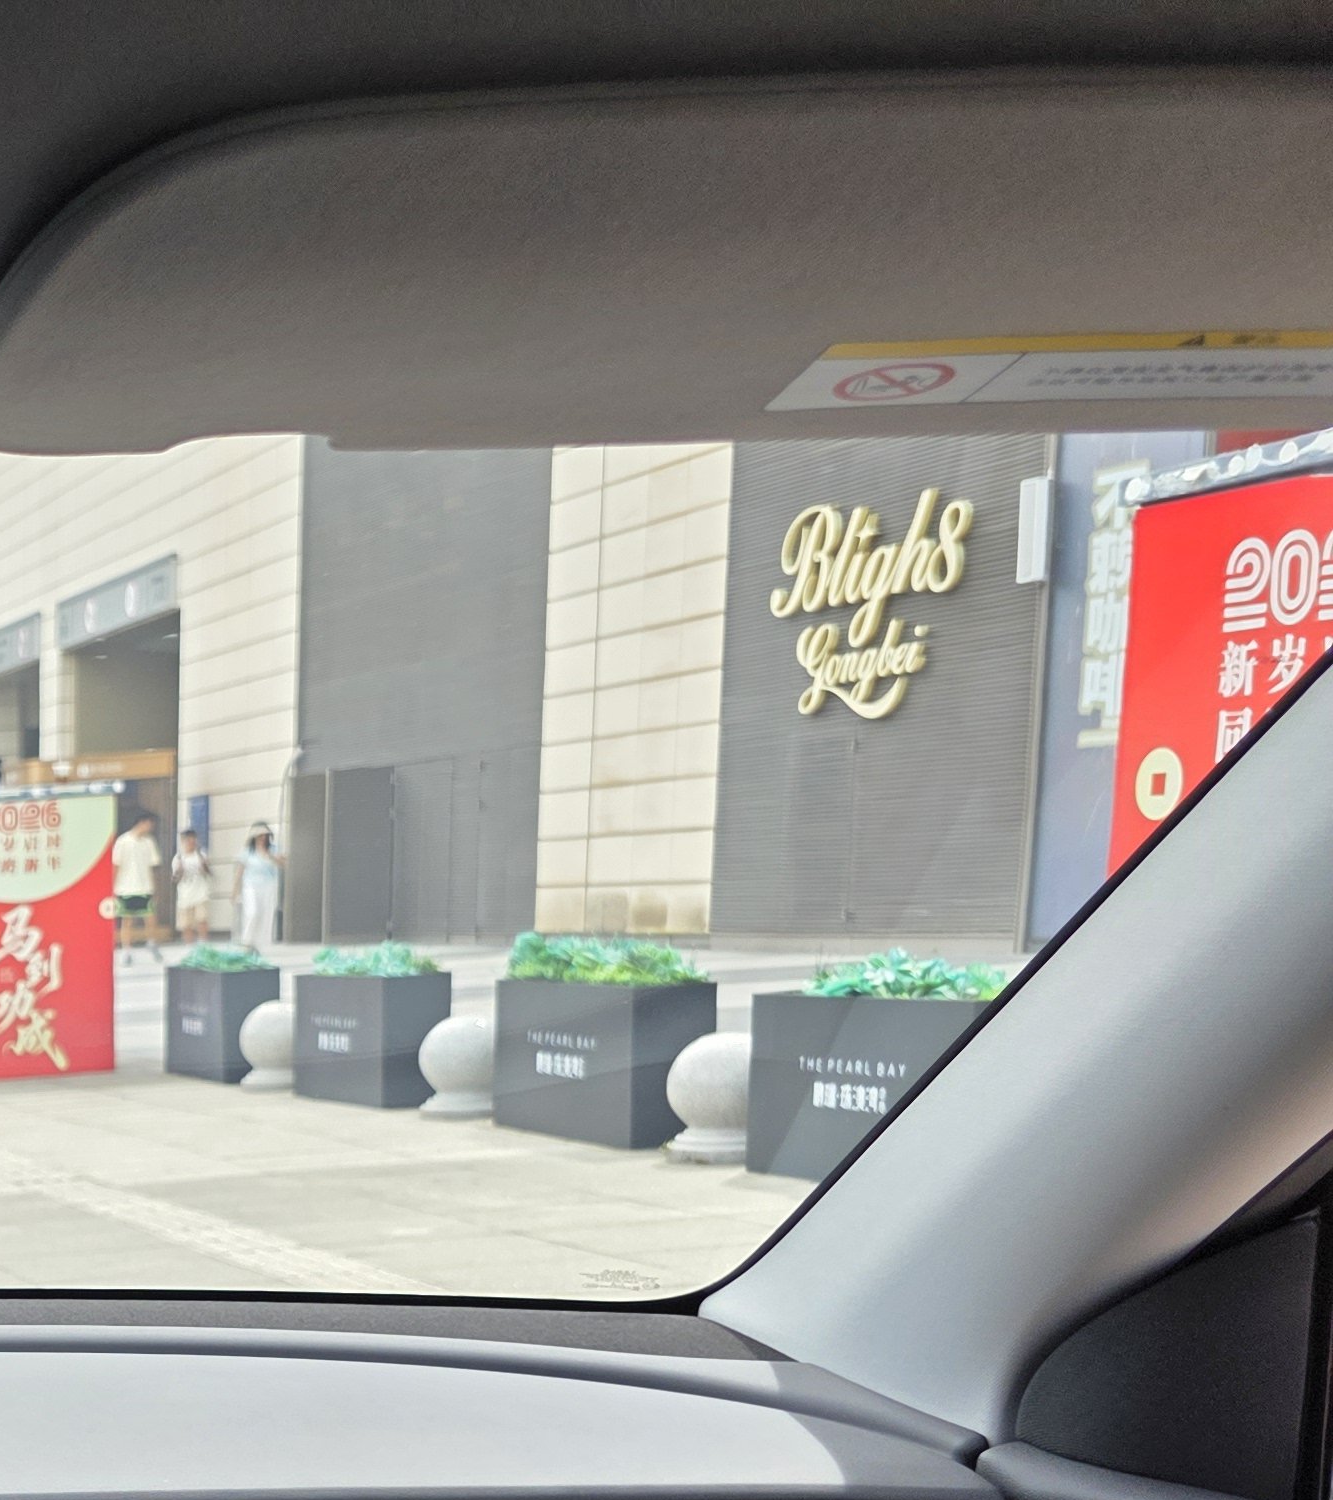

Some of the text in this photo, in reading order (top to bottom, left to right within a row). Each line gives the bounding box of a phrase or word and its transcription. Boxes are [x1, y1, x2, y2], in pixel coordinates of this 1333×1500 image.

[796, 618, 930, 719] Gongbei
[1218, 633, 1333, 698] 新岁
[799, 1055, 907, 1079] THE PEARL BAY
